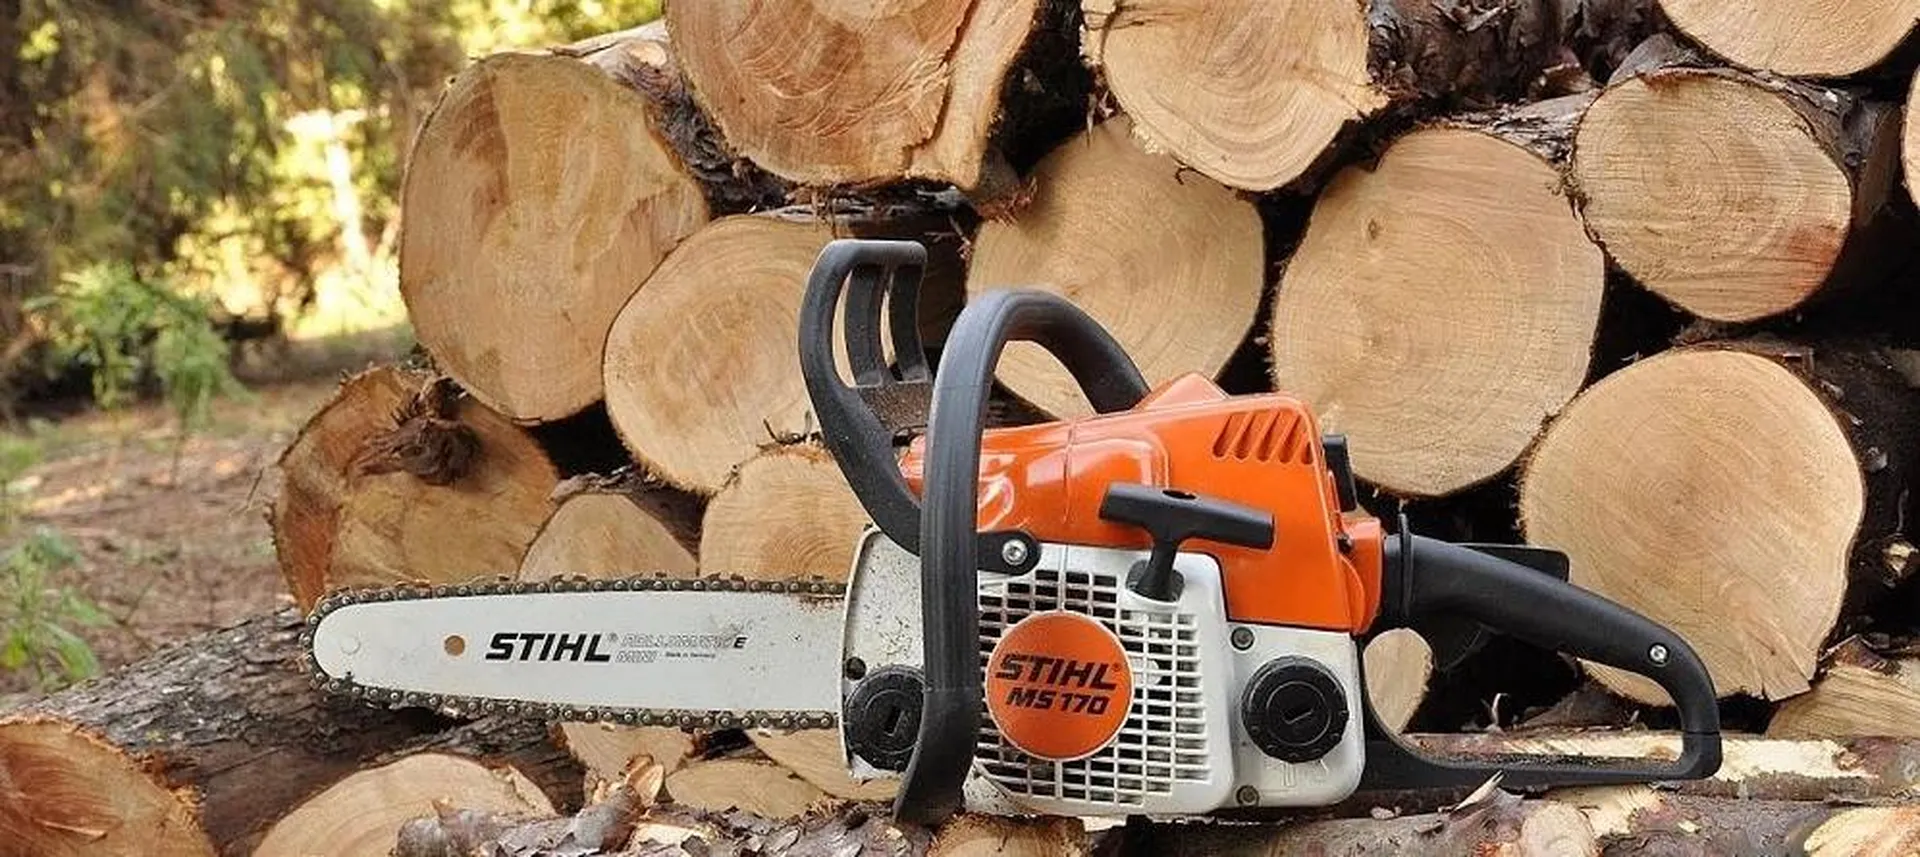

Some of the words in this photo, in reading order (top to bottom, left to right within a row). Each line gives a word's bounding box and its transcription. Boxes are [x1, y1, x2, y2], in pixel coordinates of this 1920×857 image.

[486, 633, 611, 662] STIHL
[733, 636, 748, 649] E
[996, 653, 1117, 691] STIHL
[1007, 688, 1057, 710] MS
[1058, 693, 1110, 716] 170
